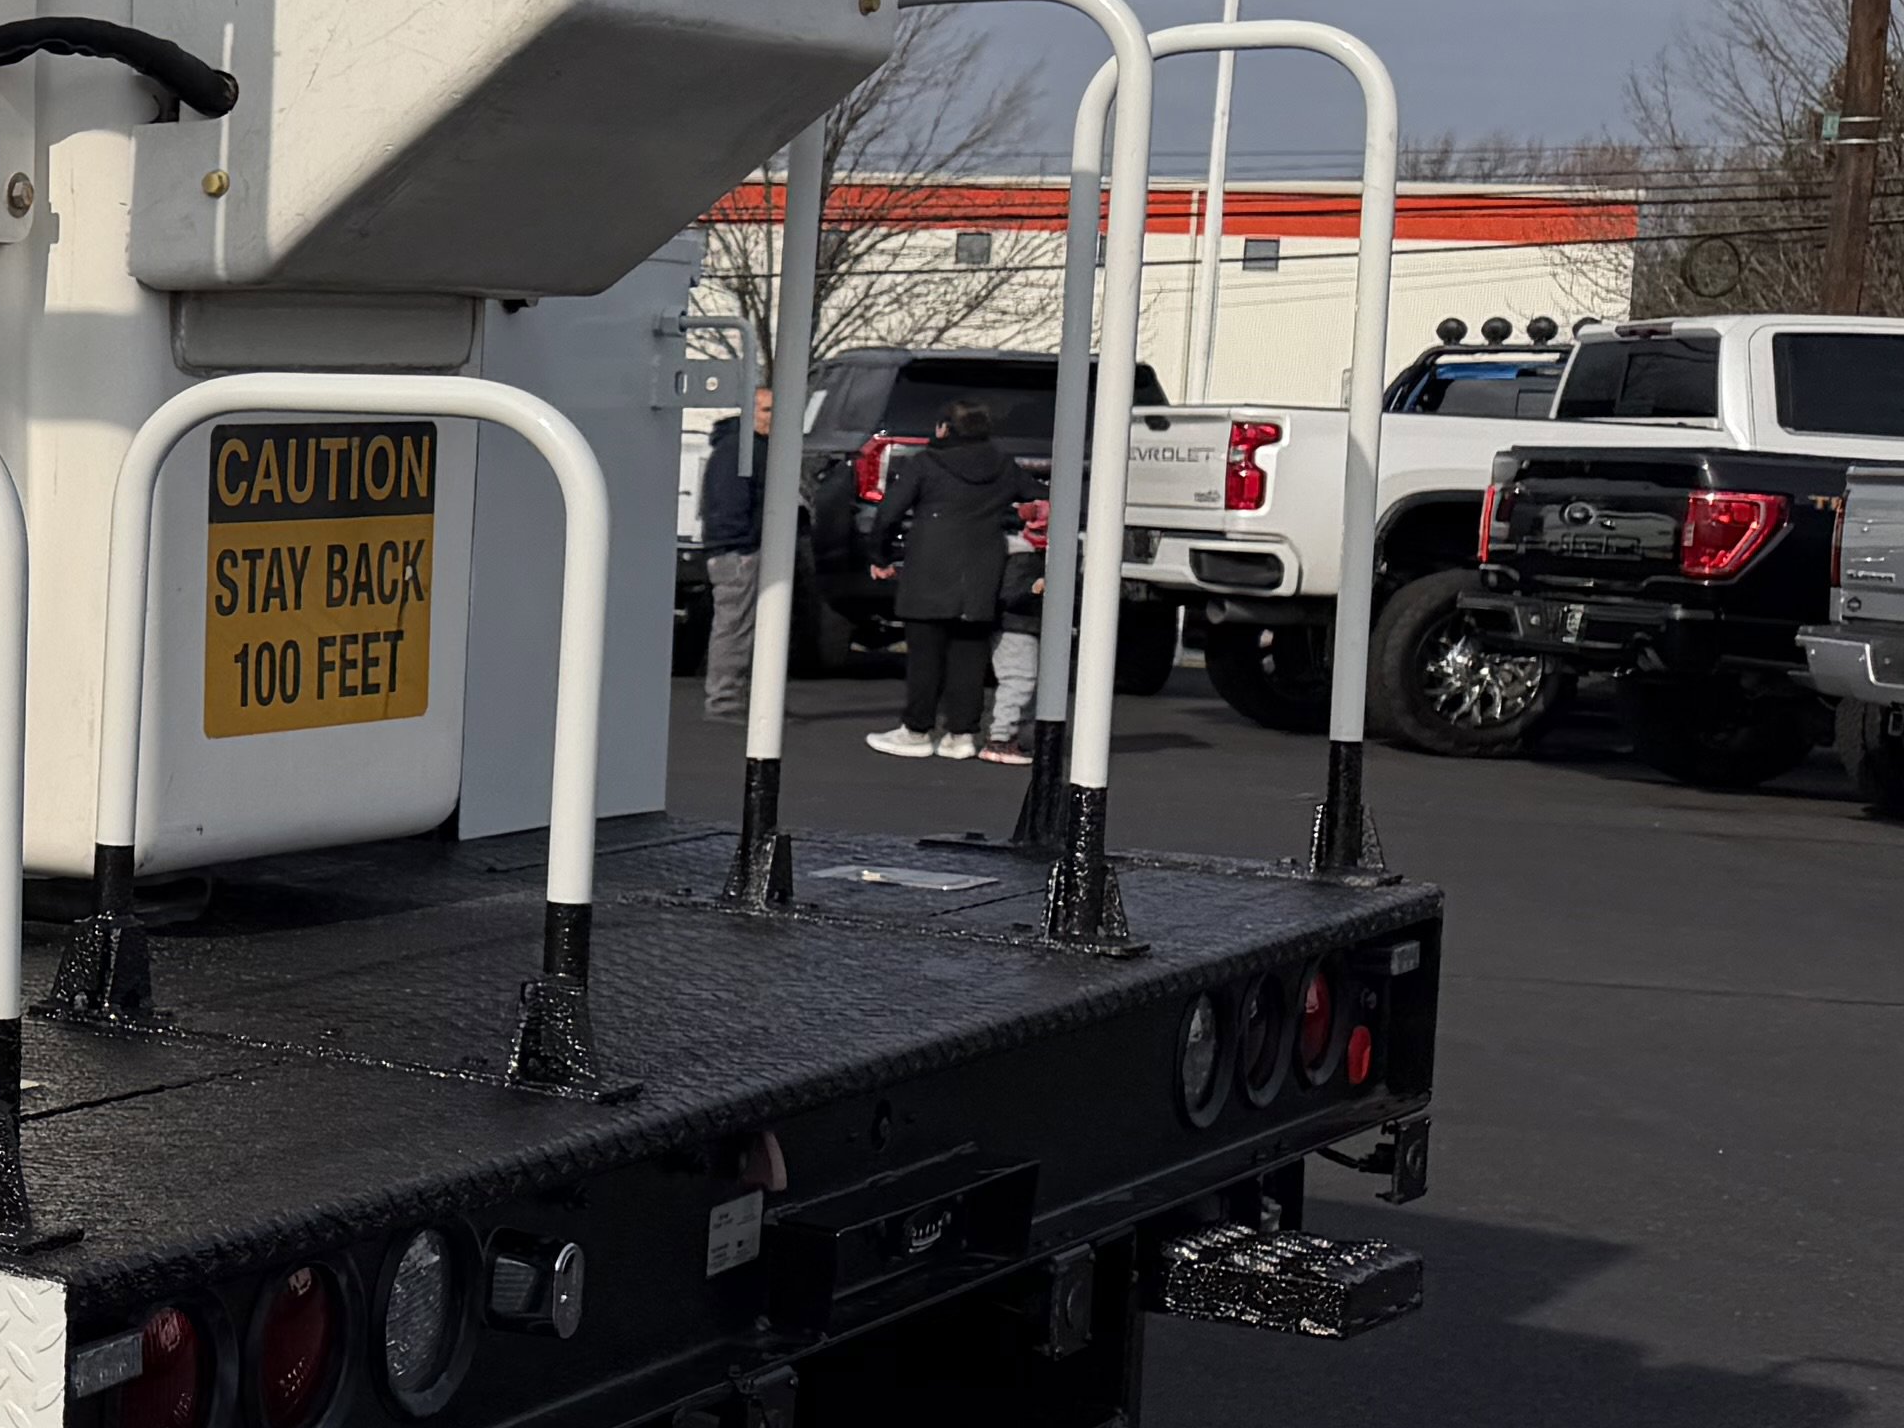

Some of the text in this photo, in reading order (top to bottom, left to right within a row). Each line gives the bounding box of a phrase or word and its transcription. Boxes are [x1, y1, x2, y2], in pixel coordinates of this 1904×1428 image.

[216, 434, 430, 506] CAUTION
[1128, 446, 1215, 463] EVROLET
[214, 538, 425, 617] STAY BACK
[234, 629, 404, 707] 100 FEET
